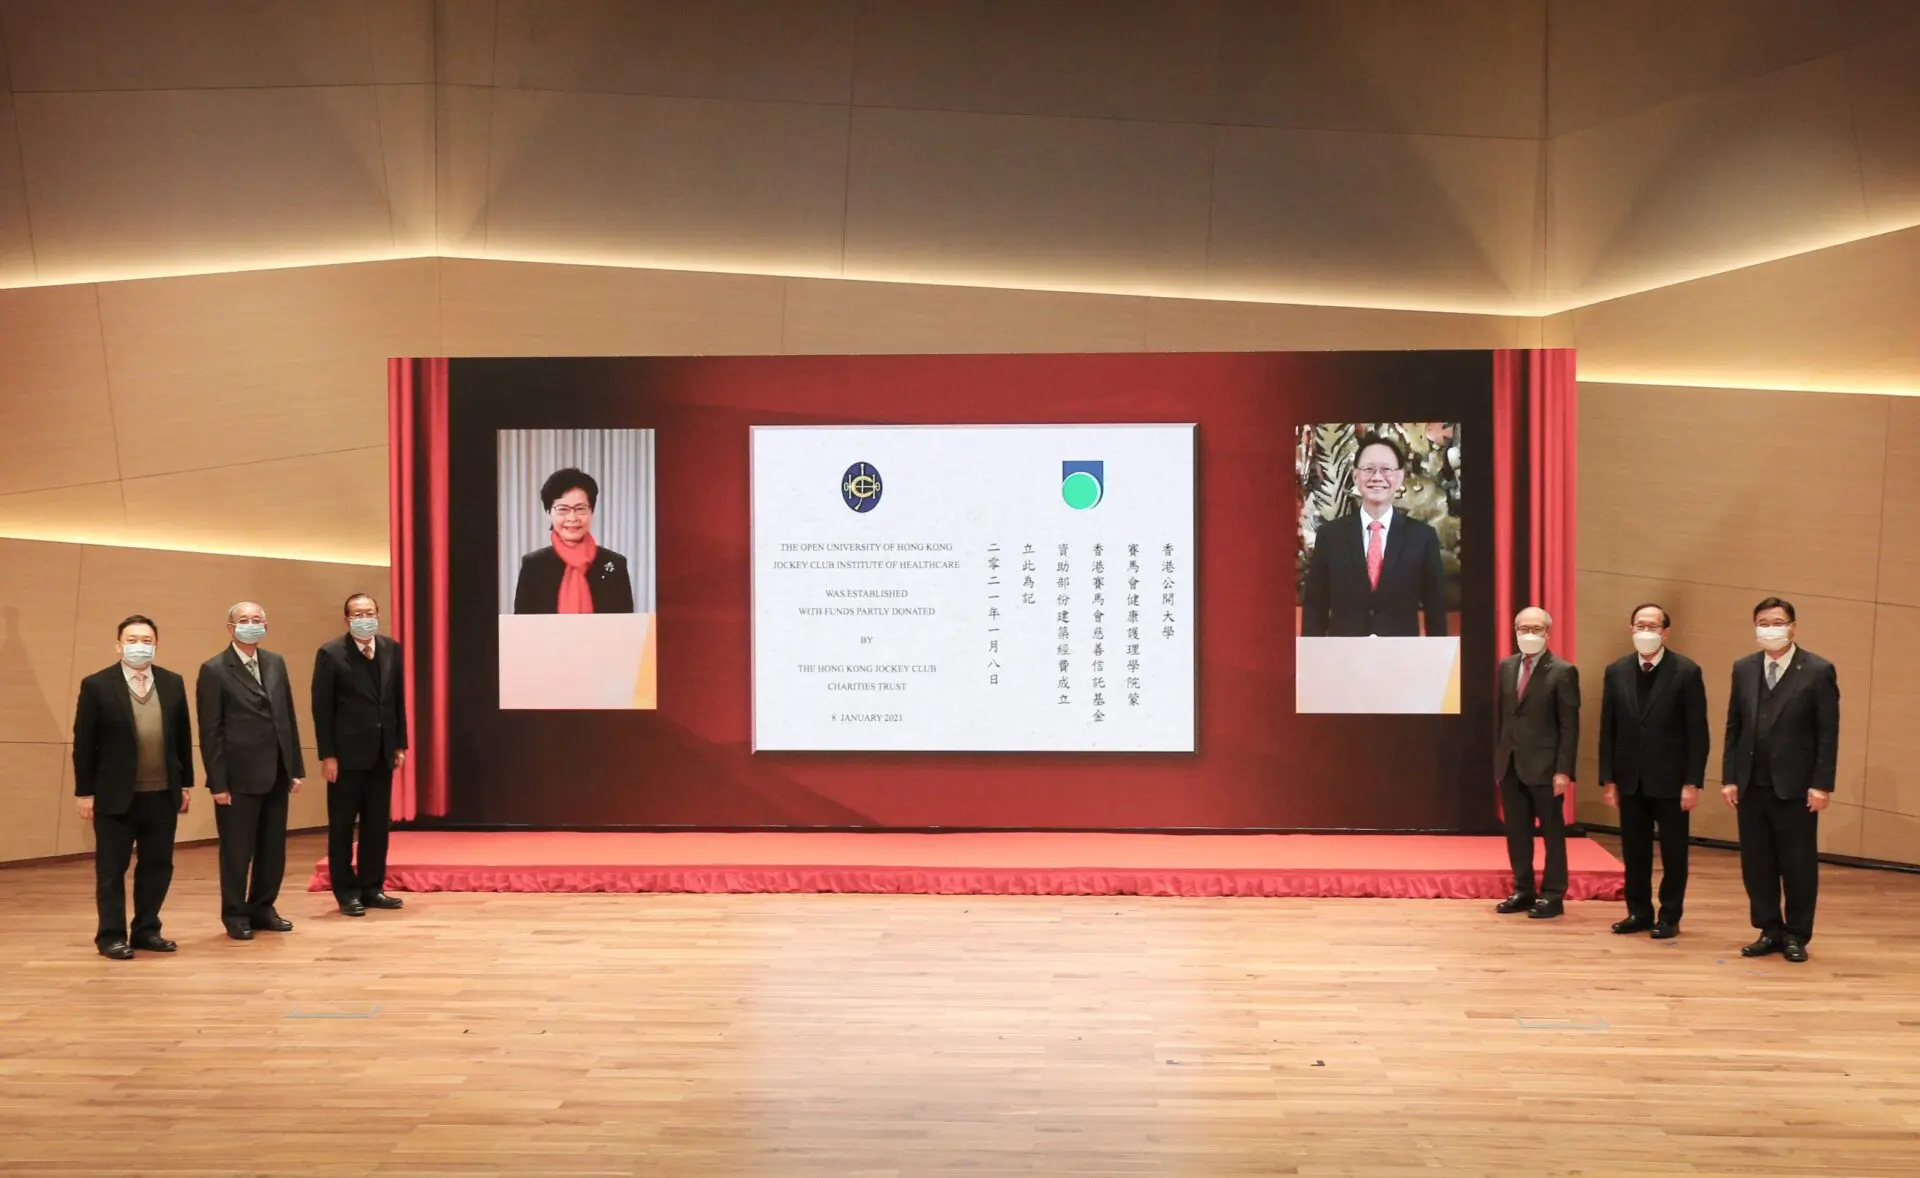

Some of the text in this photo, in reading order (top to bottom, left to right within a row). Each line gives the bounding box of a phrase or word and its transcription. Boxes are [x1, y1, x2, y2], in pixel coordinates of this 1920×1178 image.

[780, 543, 953, 552] THE OPEN UNIVERSITY OF HONG KONG
[773, 560, 961, 569] JOCKEY CLUB INSTITUTE OF HEALTHCARE
[1021, 543, 1036, 605] 立此為記
[825, 589, 909, 598] WAS ESTABLISHED
[1161, 542, 1176, 640] 香港公開大學
[798, 607, 936, 616] WITH FUNDS PARTLY DONATED
[986, 542, 1001, 686] 二零二一年一月八日
[1126, 542, 1141, 707] 賽馬會健康護理學院蒙
[1091, 542, 1106, 723] 香港賽馬會慈善信託基金
[860, 636, 873, 644] BY
[797, 664, 937, 673] THE HONG KONG JOCKEY CLUB
[827, 682, 907, 691] CHARITIES TRUST
[840, 713, 883, 722] JANUARY
[884, 713, 903, 722] 2021
